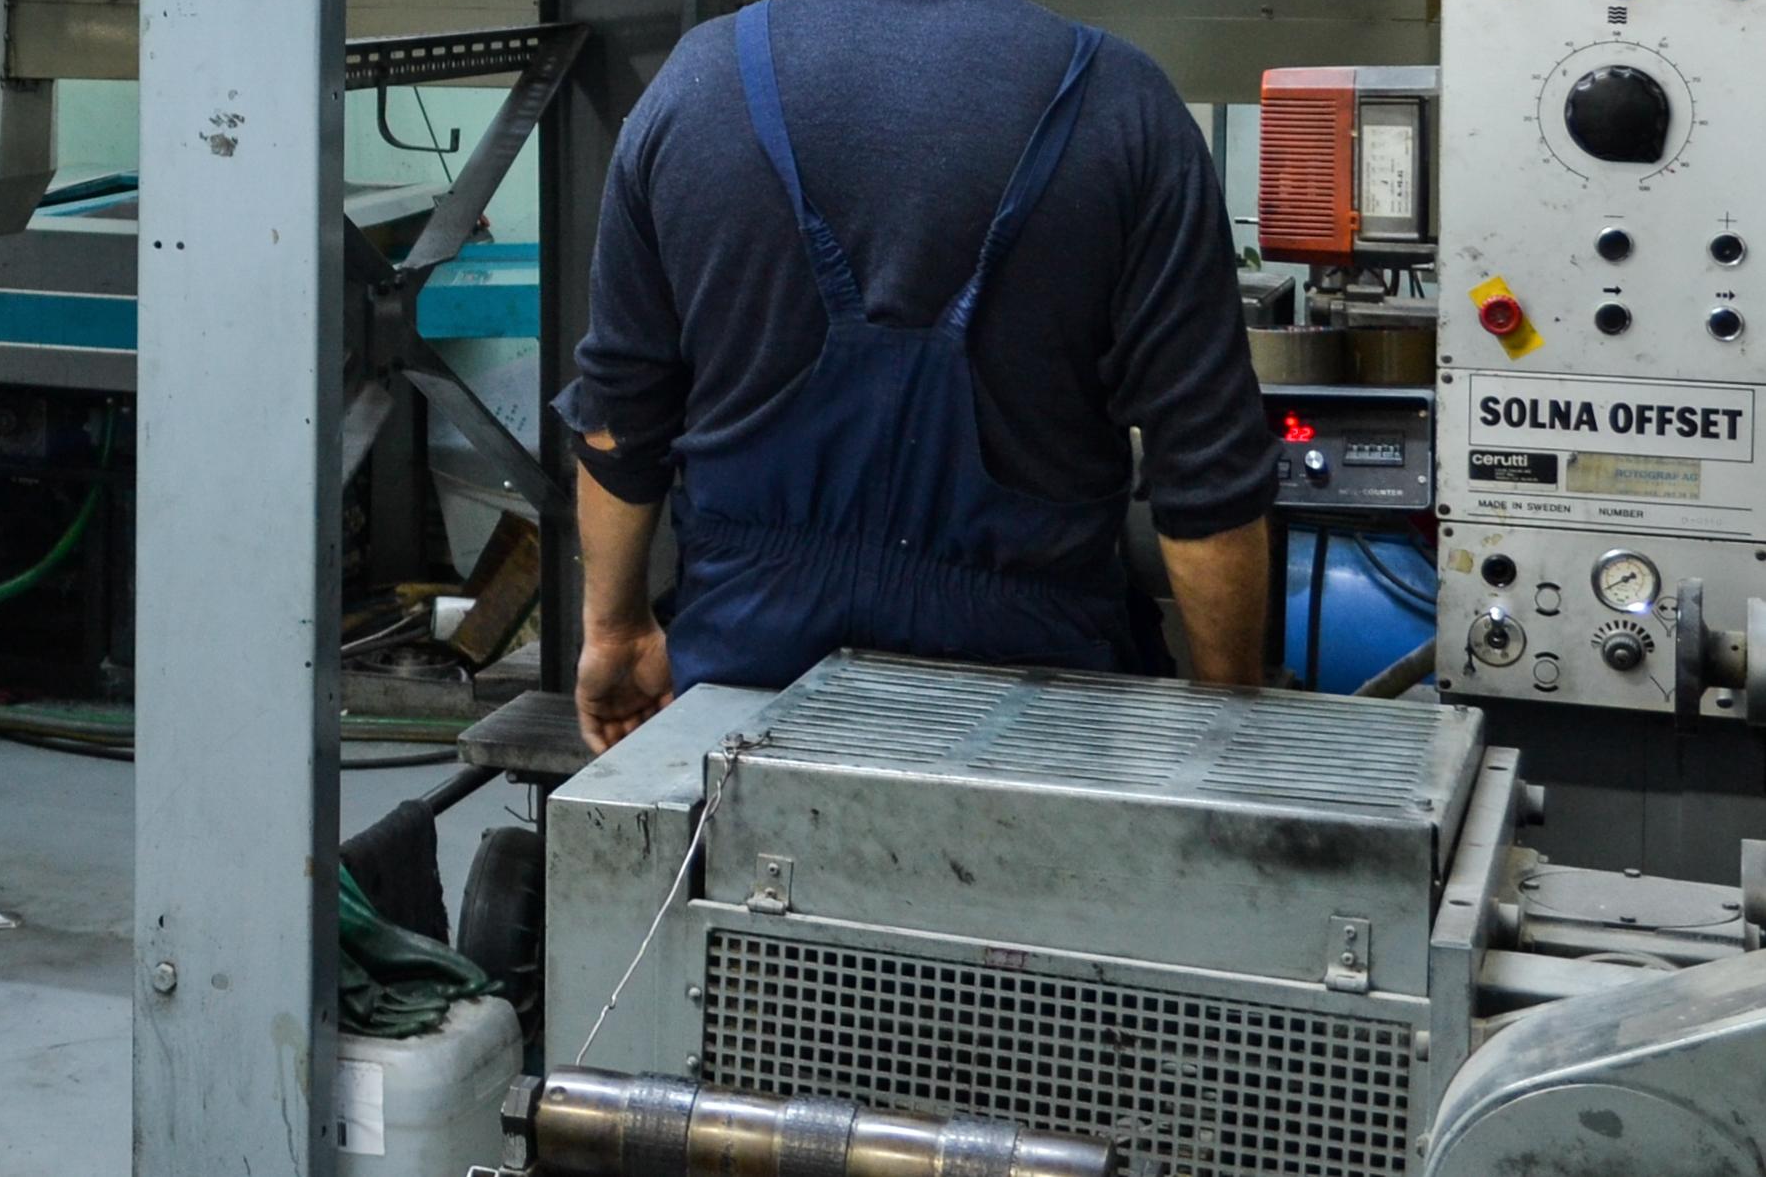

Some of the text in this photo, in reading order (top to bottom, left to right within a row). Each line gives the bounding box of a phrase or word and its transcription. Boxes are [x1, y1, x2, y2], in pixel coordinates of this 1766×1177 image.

[1479, 395, 1743, 440] SOLNA OFFSET
[1472, 453, 1529, 467] cerutti
[1614, 468, 1679, 481] ROTOGRAF
[1478, 499, 1644, 519] MADE IN SWEDEN NUMBER
